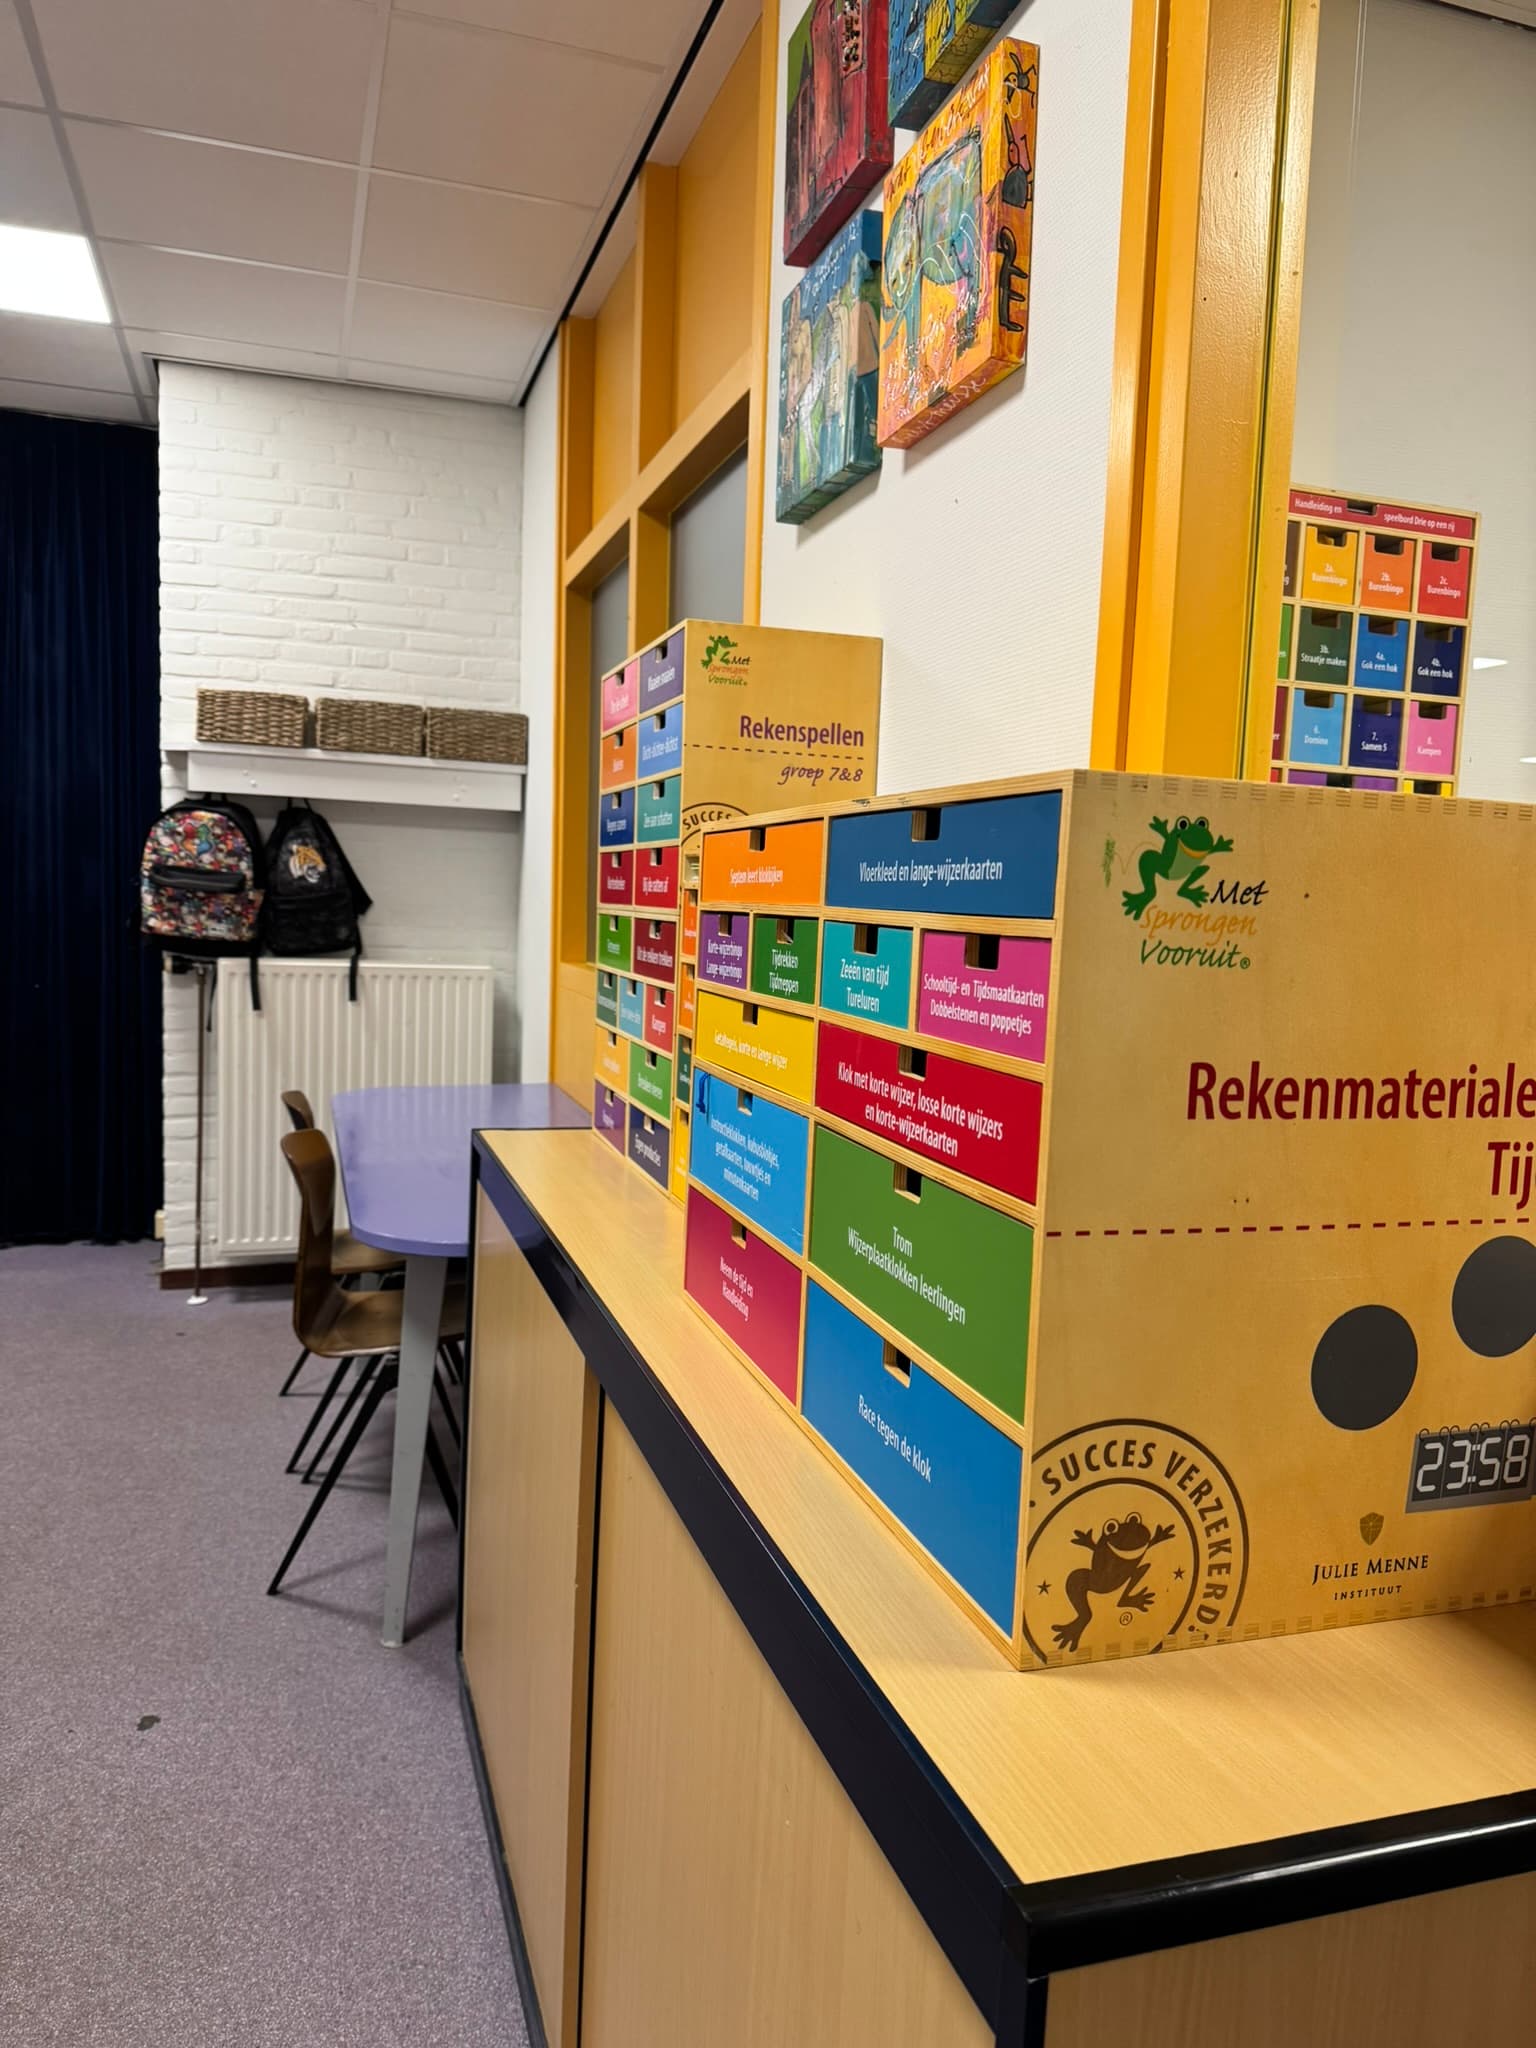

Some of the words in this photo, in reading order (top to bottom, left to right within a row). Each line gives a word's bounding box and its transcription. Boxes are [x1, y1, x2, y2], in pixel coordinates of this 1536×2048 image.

[1334, 506, 1342, 514] en
[1384, 512, 1414, 525] speelbord
[1414, 514, 1426, 527] Drie
[1427, 518, 1435, 529] op
[1436, 520, 1447, 529] een
[1448, 521, 1456, 532] rij
[731, 656, 750, 665] Met
[1301, 652, 1325, 666] Straatje
[1326, 657, 1347, 666] maken
[1361, 659, 1373, 670] Gok
[1374, 662, 1386, 671] een
[1387, 662, 1398, 673] hok
[1417, 666, 1430, 676] Gok
[1430, 668, 1442, 677] een
[740, 715, 864, 749] Rekenspellen
[1361, 741, 1383, 752] Samen
[777, 765, 824, 787] groep
[828, 766, 864, 782] 7&8
[859, 860, 898, 882] Vloerkleed
[899, 866, 909, 881] en
[910, 857, 1002, 887] lange-wijzerkaarten
[1209, 879, 1269, 905] Met
[1140, 905, 1258, 946] Sprongen
[840, 958, 861, 979] Zeeën
[862, 968, 876, 984] van
[876, 965, 890, 990] tijd
[846, 987, 880, 1013] Tureluren
[924, 973, 960, 1000] Schooltijd-
[961, 983, 970, 997] en
[973, 979, 1044, 1008] Tijdsmaatkaarten
[930, 999, 978, 1024] Dobbelstenen
[979, 1012, 990, 1026] en
[990, 1012, 1032, 1037] poppetjes
[837, 1061, 853, 1084] Klok
[854, 1070, 869, 1090] met
[869, 1071, 889, 1098] korte
[890, 1081, 916, 1112] wijzer,
[917, 1088, 939, 1117] losse
[940, 1096, 965, 1127] korte
[967, 1108, 1003, 1141] wijzers
[1187, 1061, 1536, 1120] Rekenmateriale
[865, 1106, 874, 1121] en
[875, 1103, 958, 1157] korte-wijzerkaarten
[1488, 1141, 1536, 1210] Tij
[893, 1226, 912, 1257] Trom
[848, 1226, 918, 1293] Wijzerplaatklokken
[920, 1273, 966, 1325] leerlingen
[858, 1393, 876, 1428] Race
[877, 1414, 900, 1451] tegen
[900, 1435, 912, 1463] de
[912, 1444, 932, 1483] klok
[1041, 1440, 1157, 1496] SUCCES
[1416, 1434, 1530, 1492] 23:58
[1312, 1562, 1359, 1586] JULIE
[1366, 1555, 1430, 1576] MENNE
[1334, 1585, 1403, 1601] INSTITUUT
